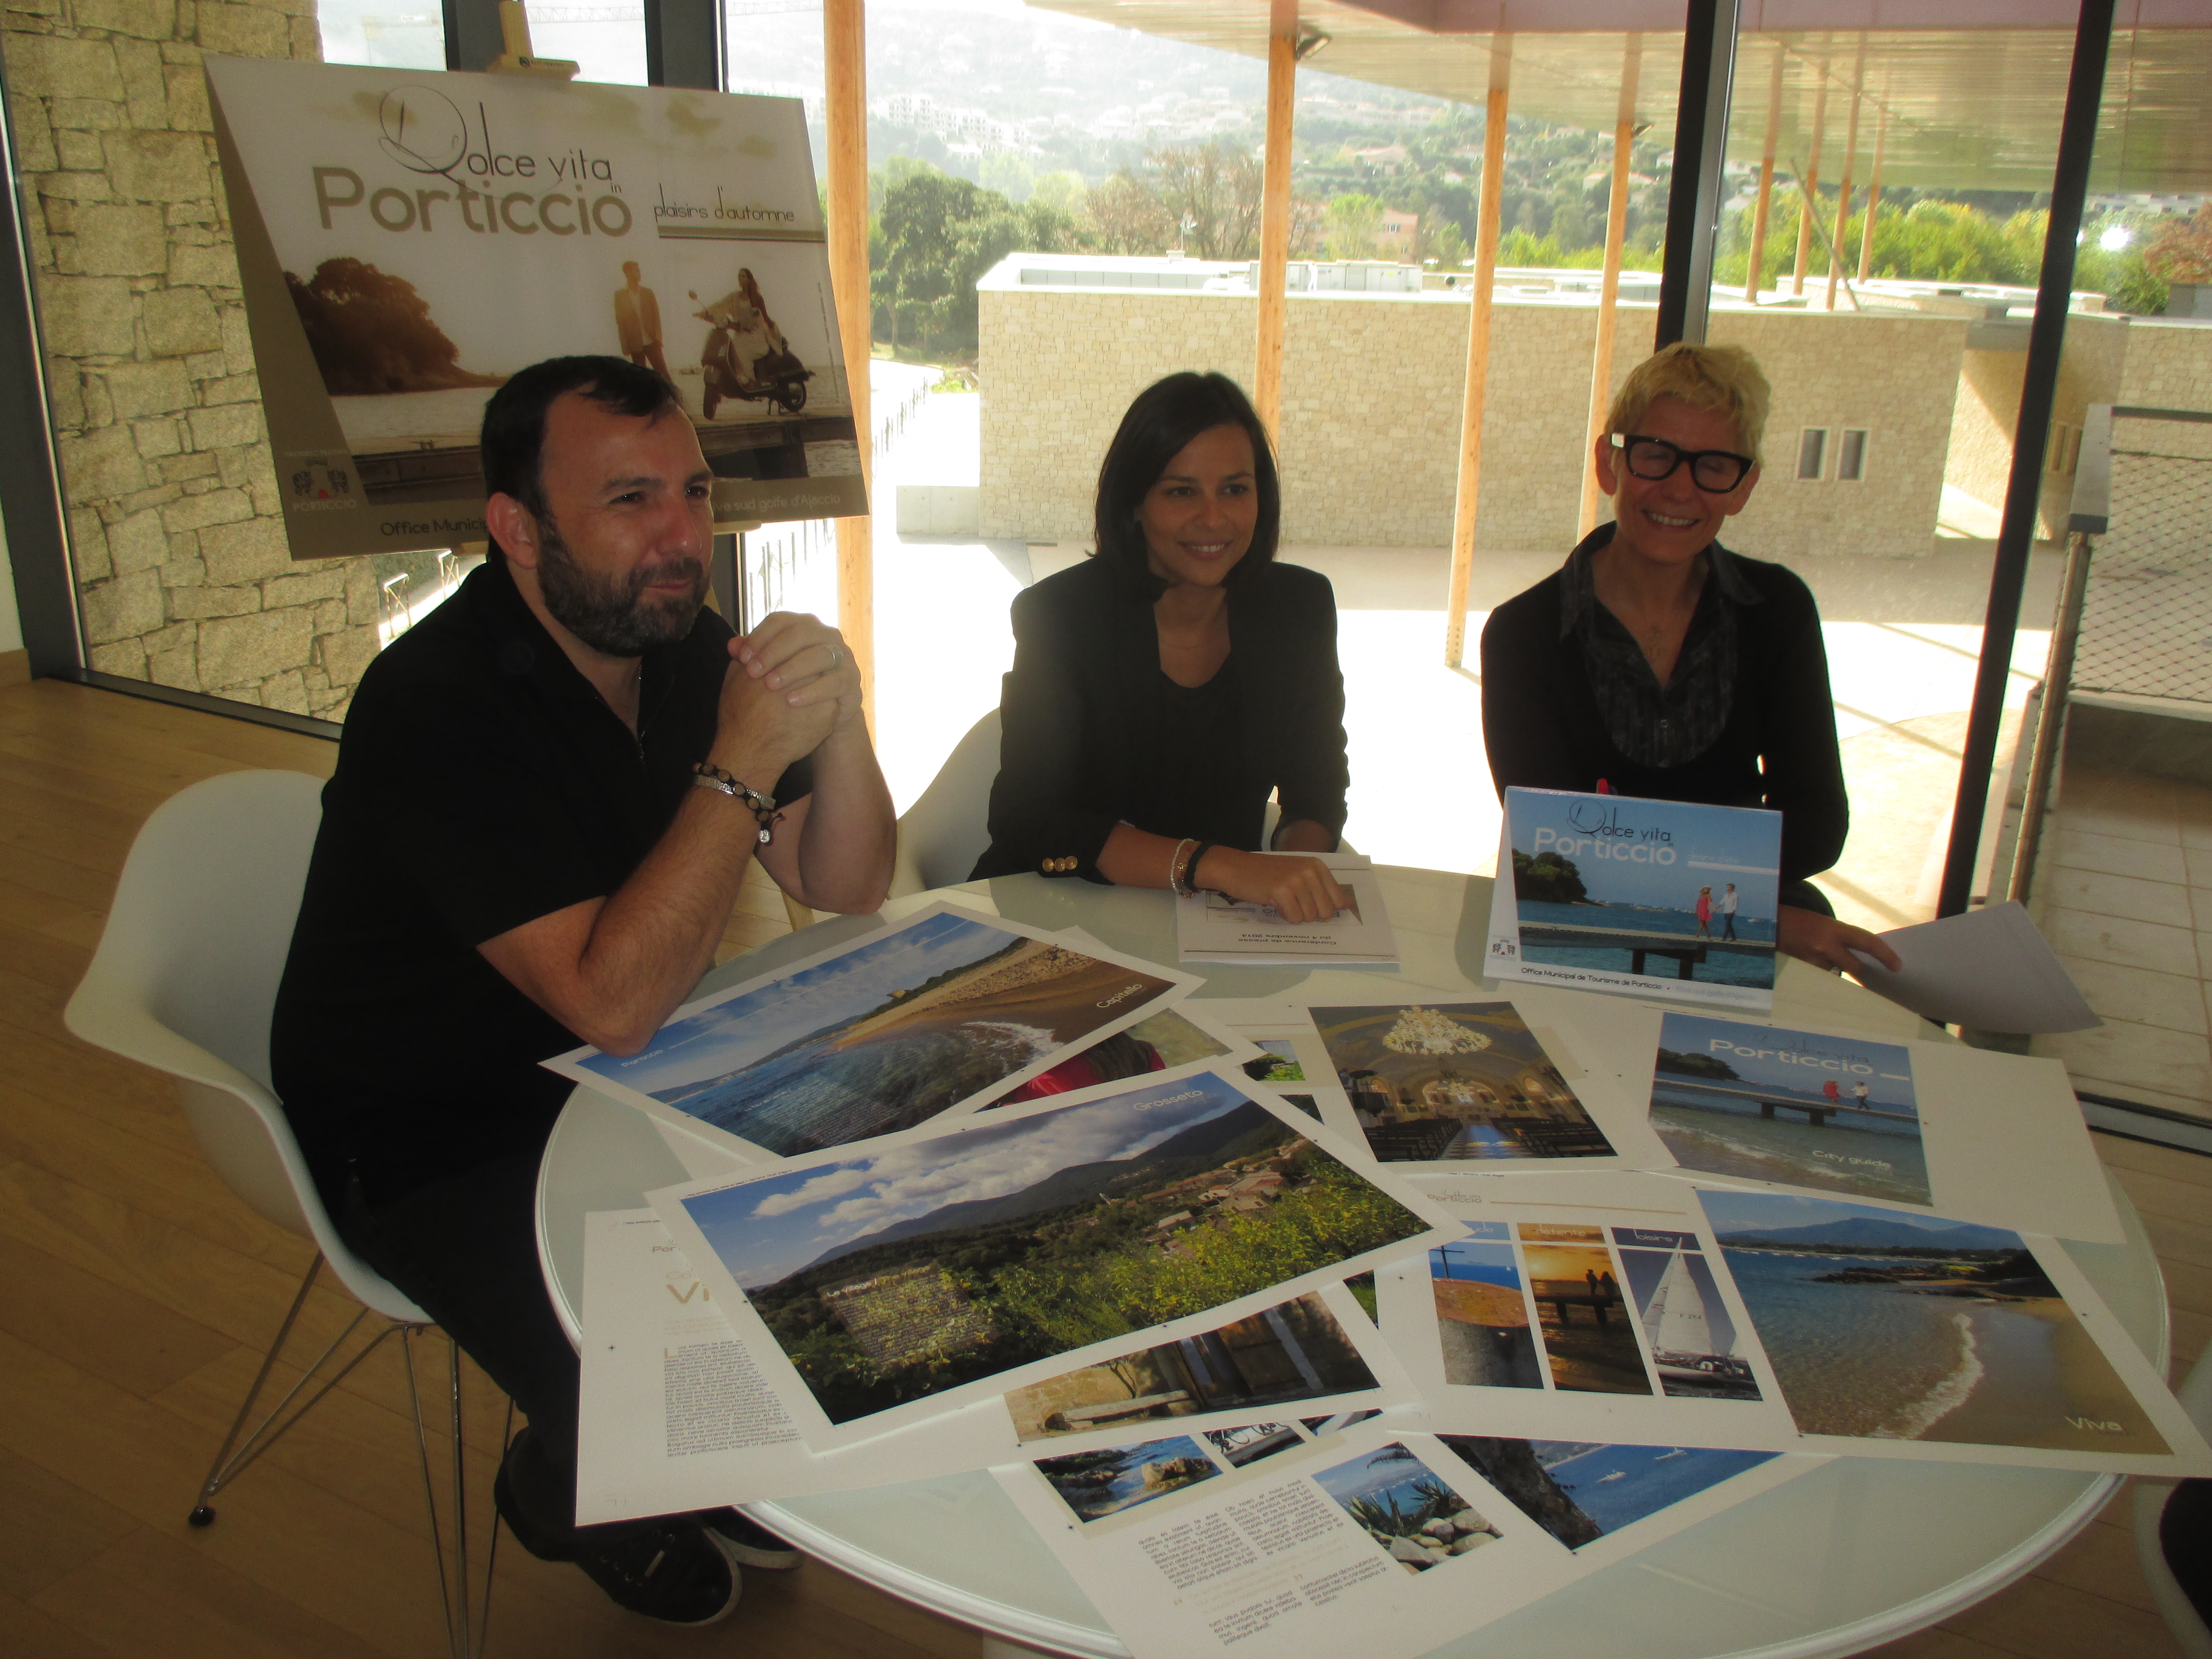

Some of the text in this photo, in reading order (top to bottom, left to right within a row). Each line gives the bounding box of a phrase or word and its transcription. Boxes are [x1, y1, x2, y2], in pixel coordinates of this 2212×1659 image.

[378, 84, 612, 181] Dolce vita
[611, 181, 622, 193] in
[313, 166, 633, 237] Porticcio
[654, 183, 795, 223] plaisirs d'automne
[380, 520, 431, 536] Office
[1566, 799, 1671, 842] Dolce vita
[1534, 827, 1676, 865] Porticcio
[1521, 967, 1543, 975] Office
[1544, 970, 1575, 980] Municipal
[1587, 974, 1620, 985] Tourisme
[1632, 980, 1661, 989] Porticcio
[1096, 984, 1142, 1008] Capitello
[1710, 1038, 1874, 1075] Porticcio
[1133, 1090, 1203, 1111] Grosseto
[1812, 1150, 1893, 1169] City guide
[1535, 1224, 1586, 1237] détente
[1633, 1228, 1673, 1243] loisirs
[842, 1282, 872, 1292] village
[2064, 1416, 2125, 1431] Viva
